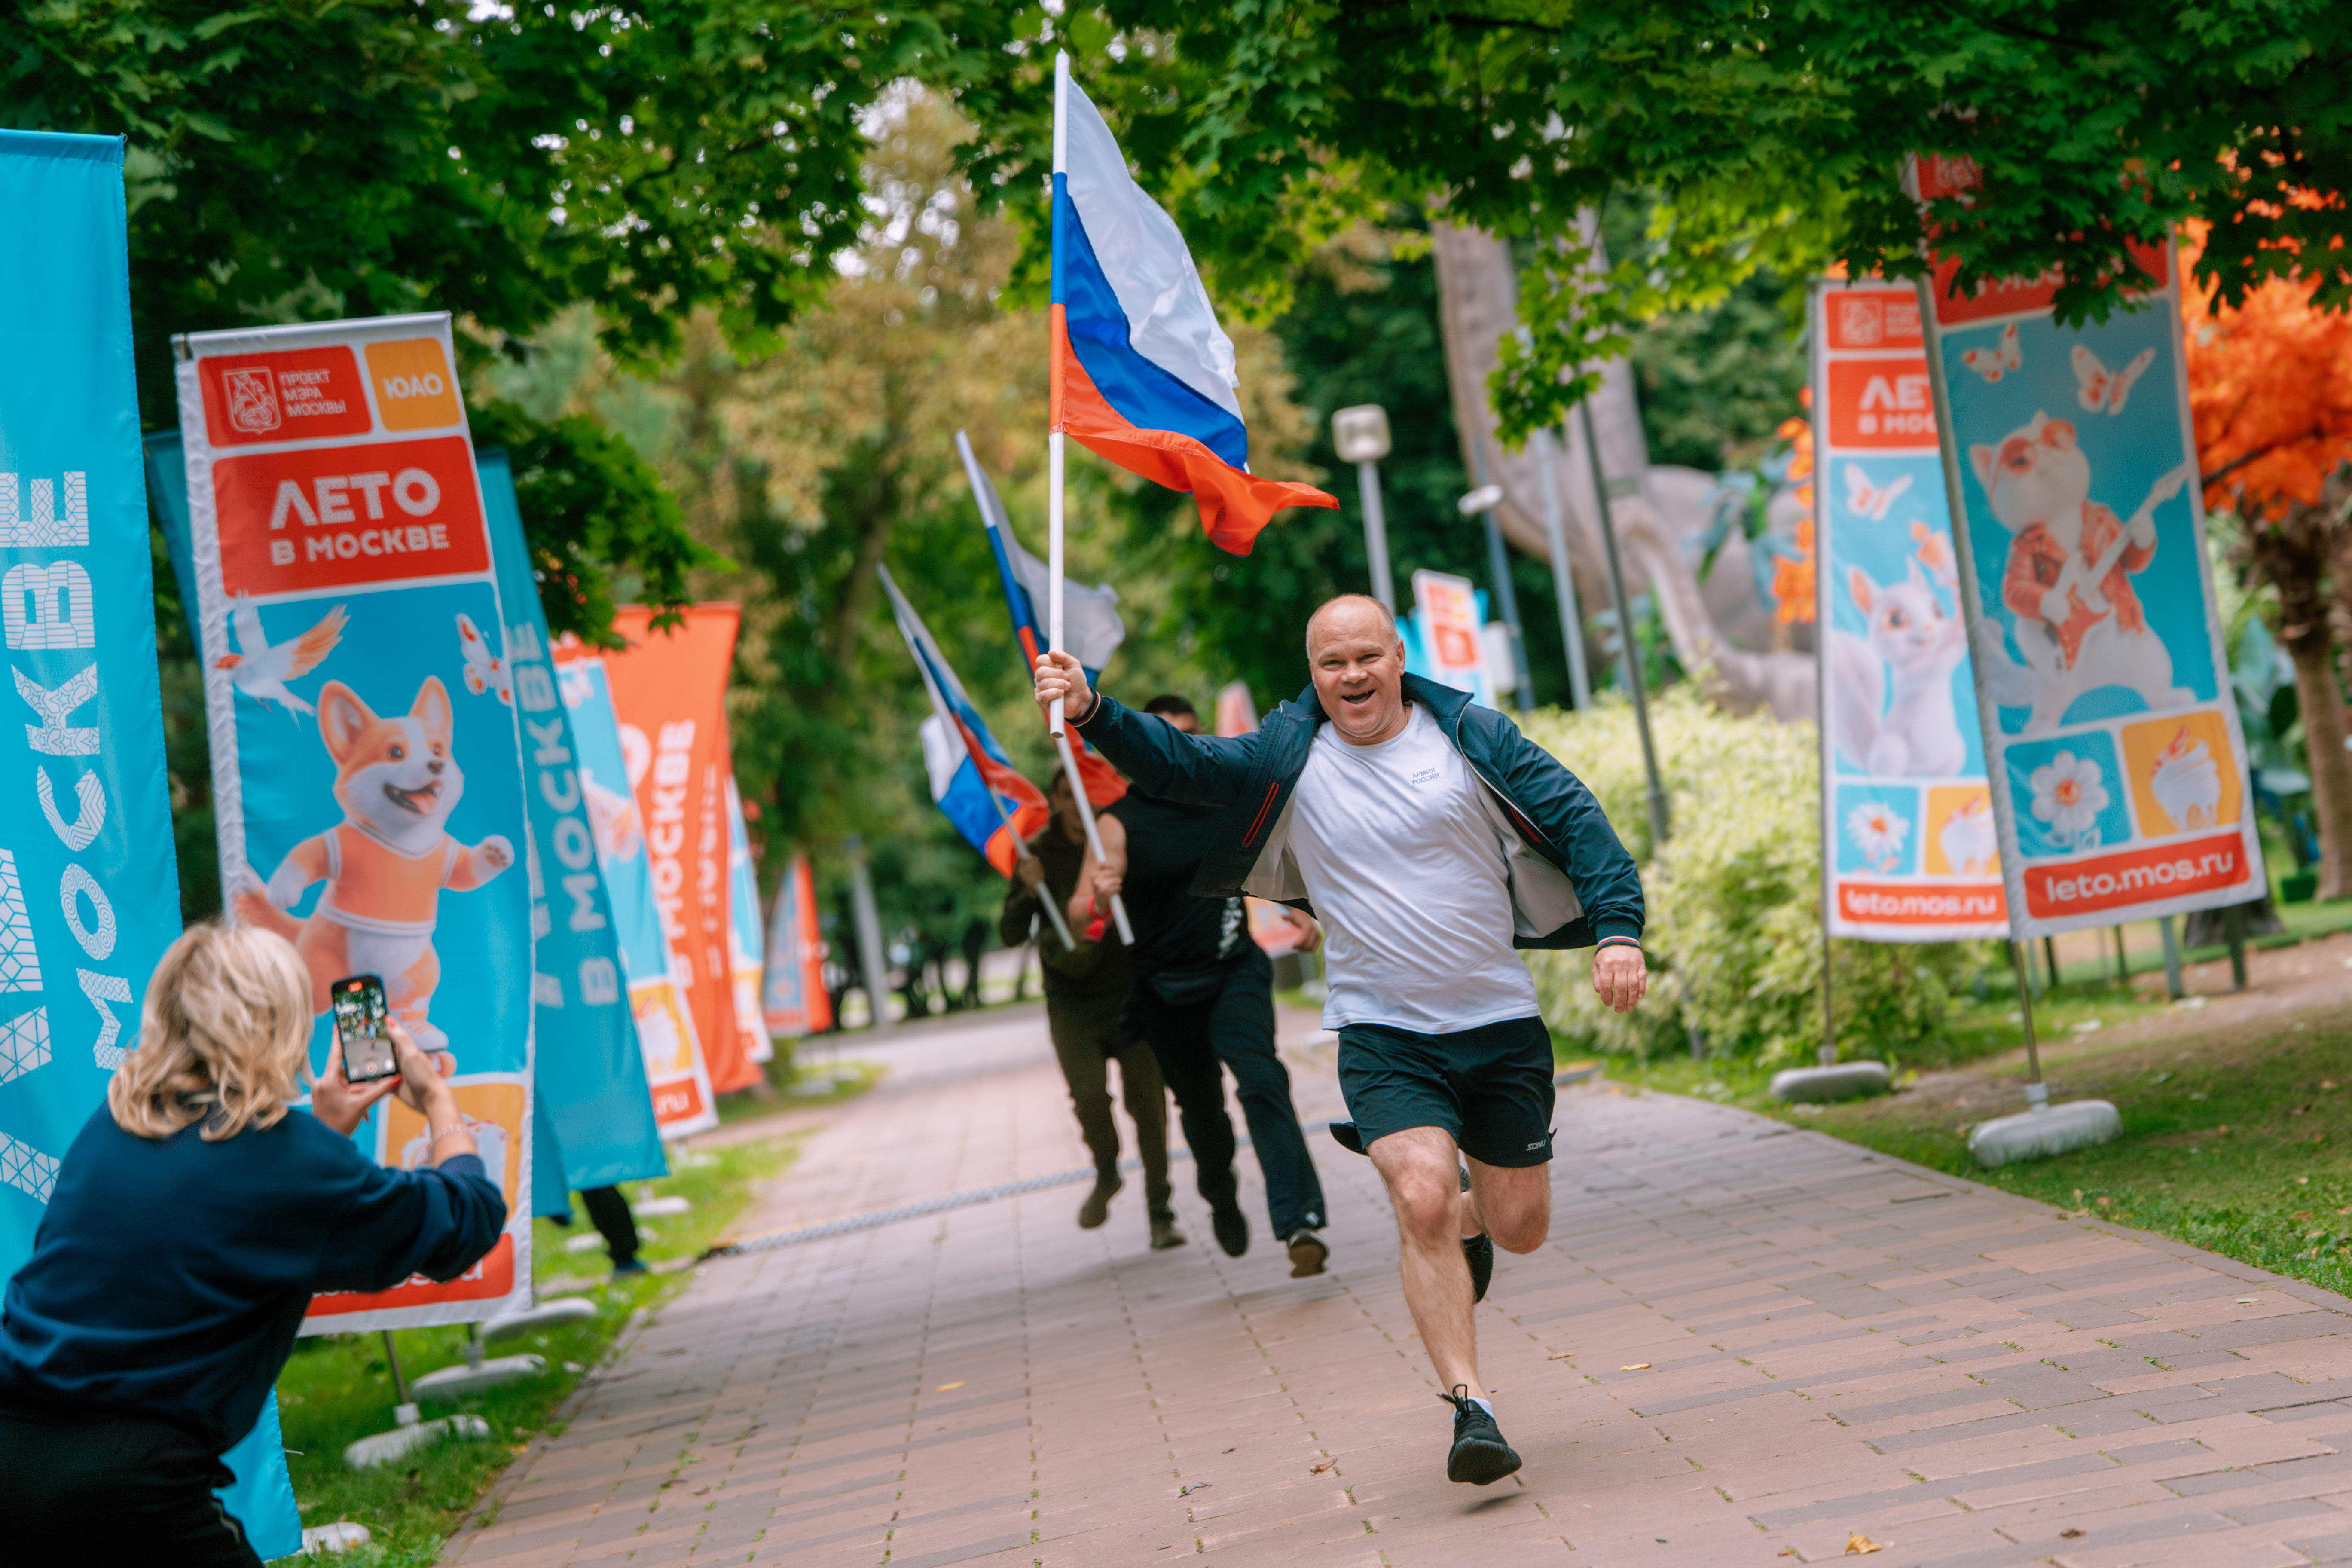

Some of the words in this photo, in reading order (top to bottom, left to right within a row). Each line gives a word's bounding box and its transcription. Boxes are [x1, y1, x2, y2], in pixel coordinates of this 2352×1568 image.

[278, 368, 330, 387] ПРОЕКТ
[383, 372, 443, 400] ЮАО
[281, 385, 324, 402] МЭРА
[285, 399, 347, 418] МОСКВЫ
[269, 467, 441, 530] ЛЕТО
[270, 538, 296, 566] В
[305, 523, 451, 562] МОСКВЕ
[0, 471, 134, 1071] МОСКВЕ
[509, 620, 607, 934] МОСКВЕ
[1411, 772, 1440, 785] РОССИИ
[1412, 767, 1436, 779] АРМИЯ
[2046, 851, 2234, 903] leto.mos.ru
[1845, 888, 1998, 917] leto.mos.ru
[577, 956, 620, 1006] В
